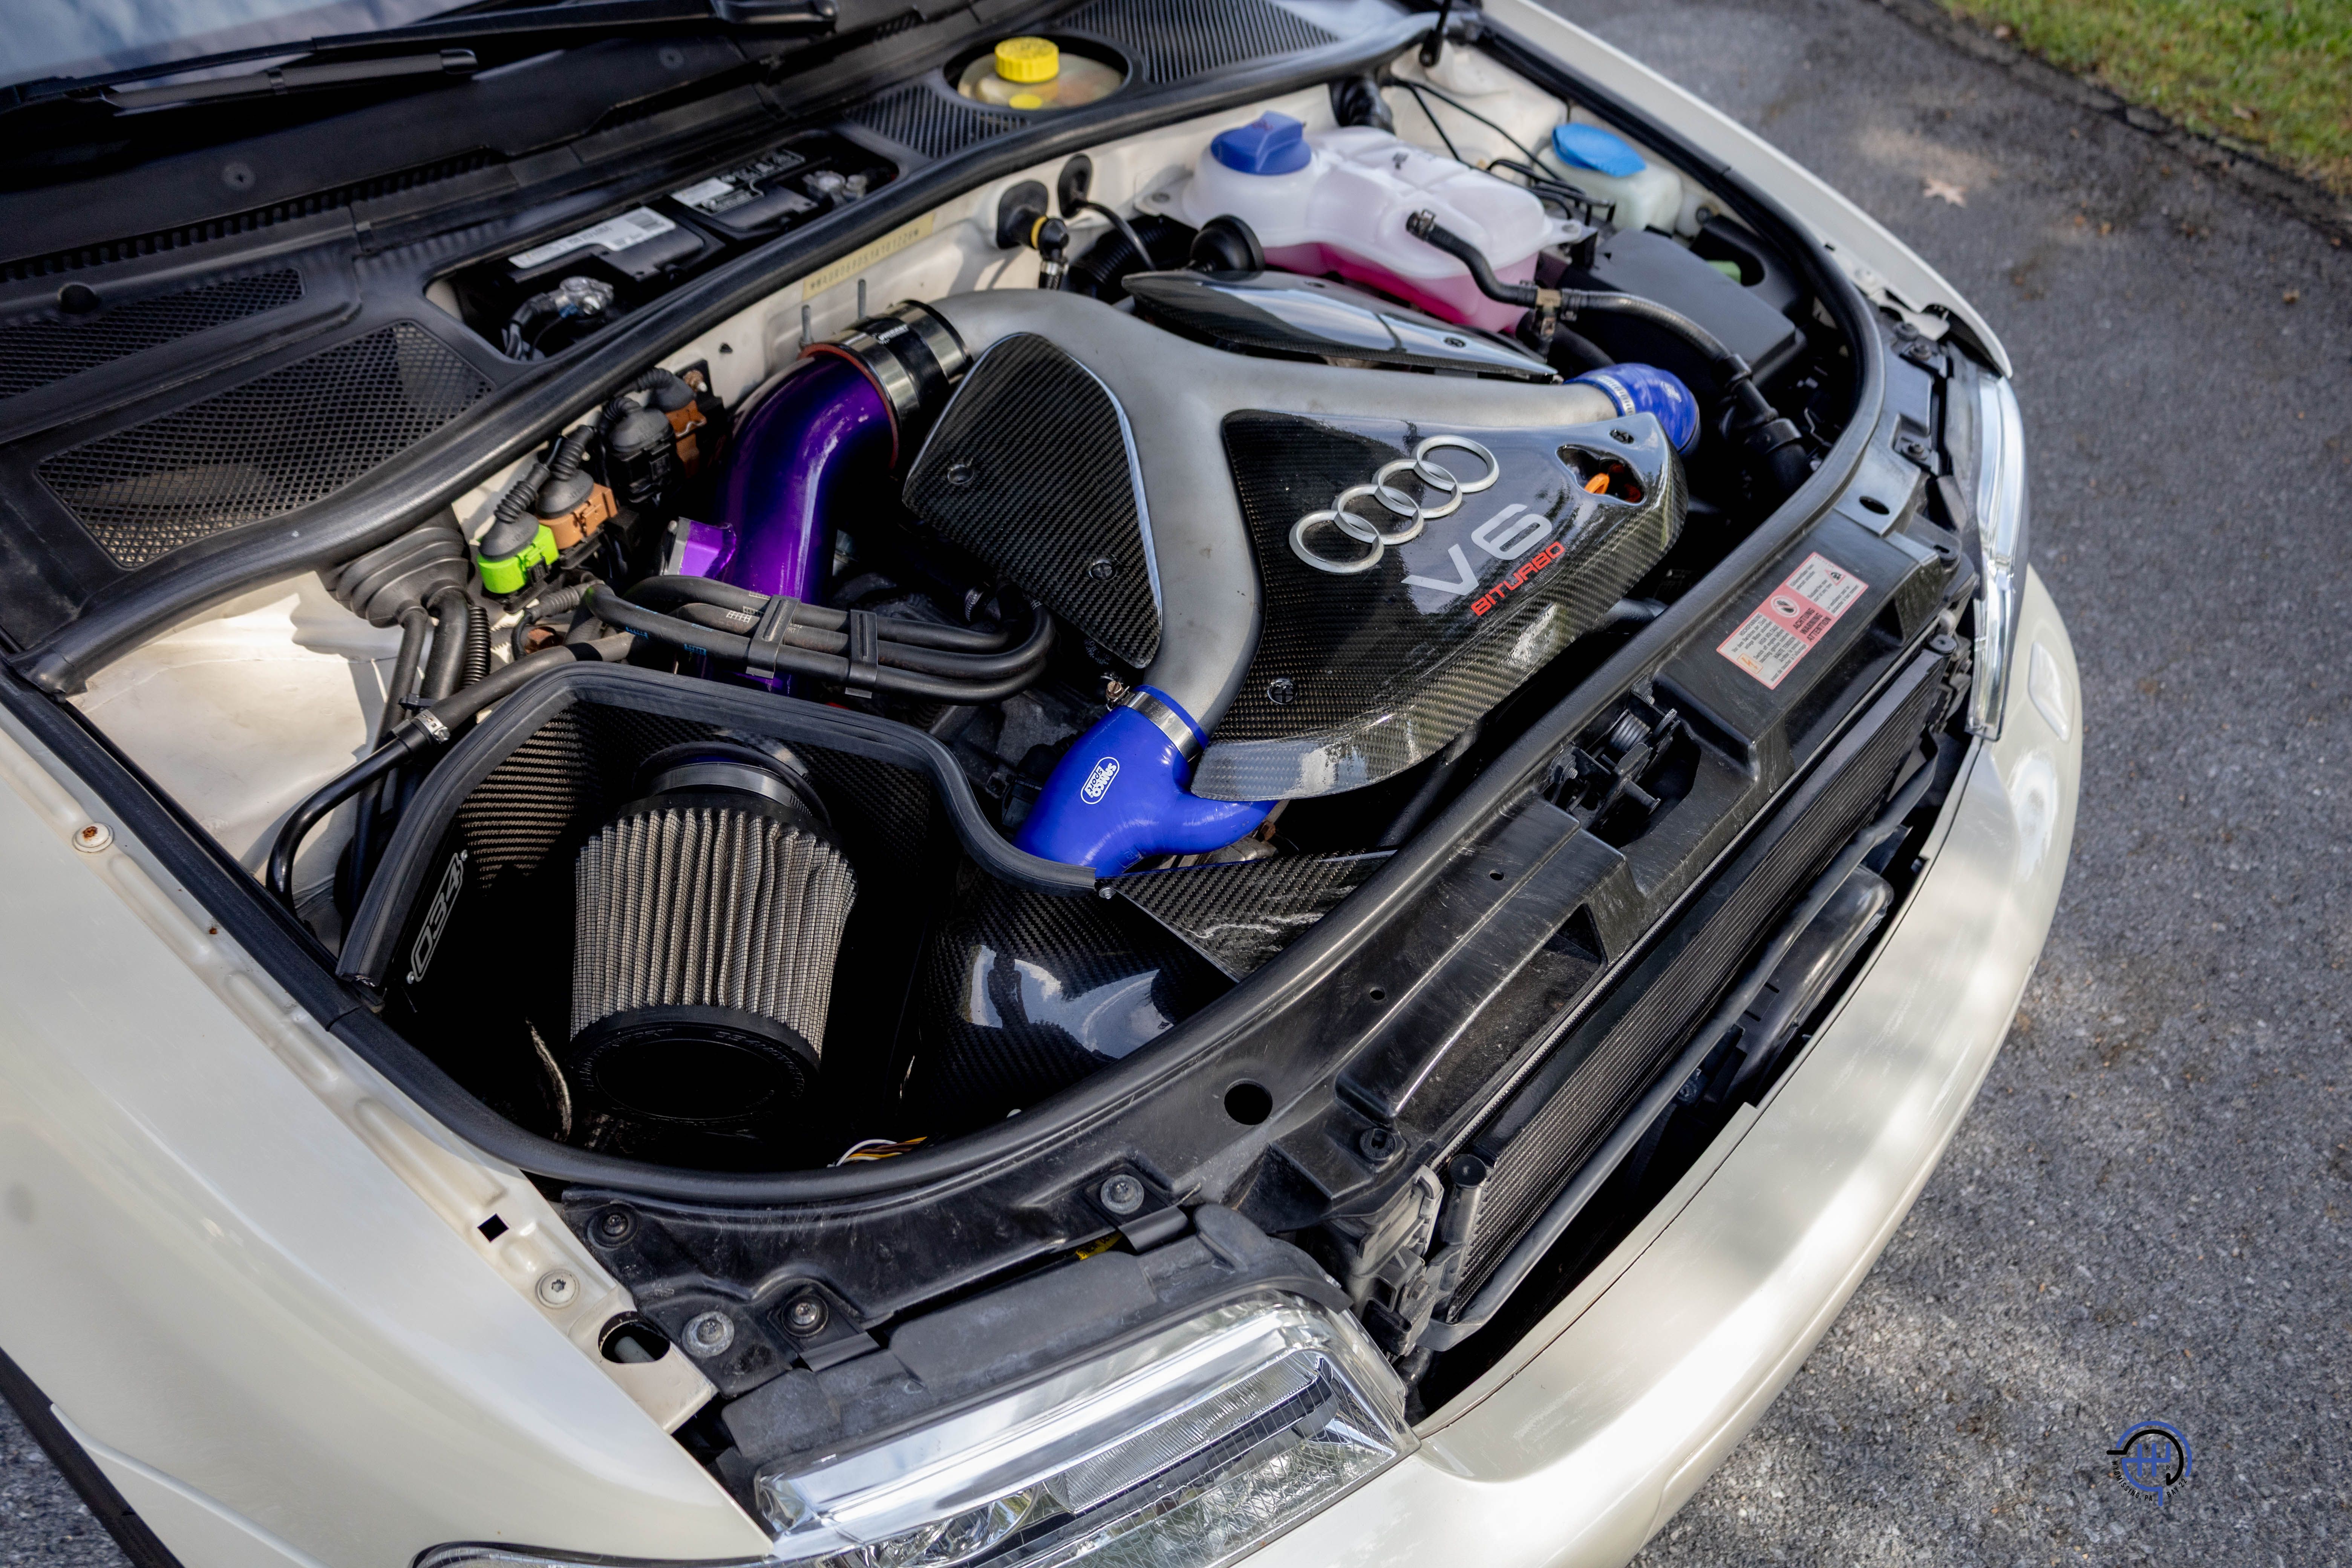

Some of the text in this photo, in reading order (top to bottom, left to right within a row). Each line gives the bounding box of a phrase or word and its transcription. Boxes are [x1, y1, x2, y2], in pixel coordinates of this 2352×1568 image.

[1401, 504, 1552, 596] V6
[1471, 541, 1566, 617] BITURBO
[1791, 607, 1816, 630] ACHTUNG
[1799, 612, 1823, 635] WARNING
[1805, 616, 1832, 642] ATTENTION
[1758, 624, 1779, 645] HIGH VOLTAGE
[1087, 768, 1103, 793] sport
[1092, 763, 1117, 797] SAMCO
